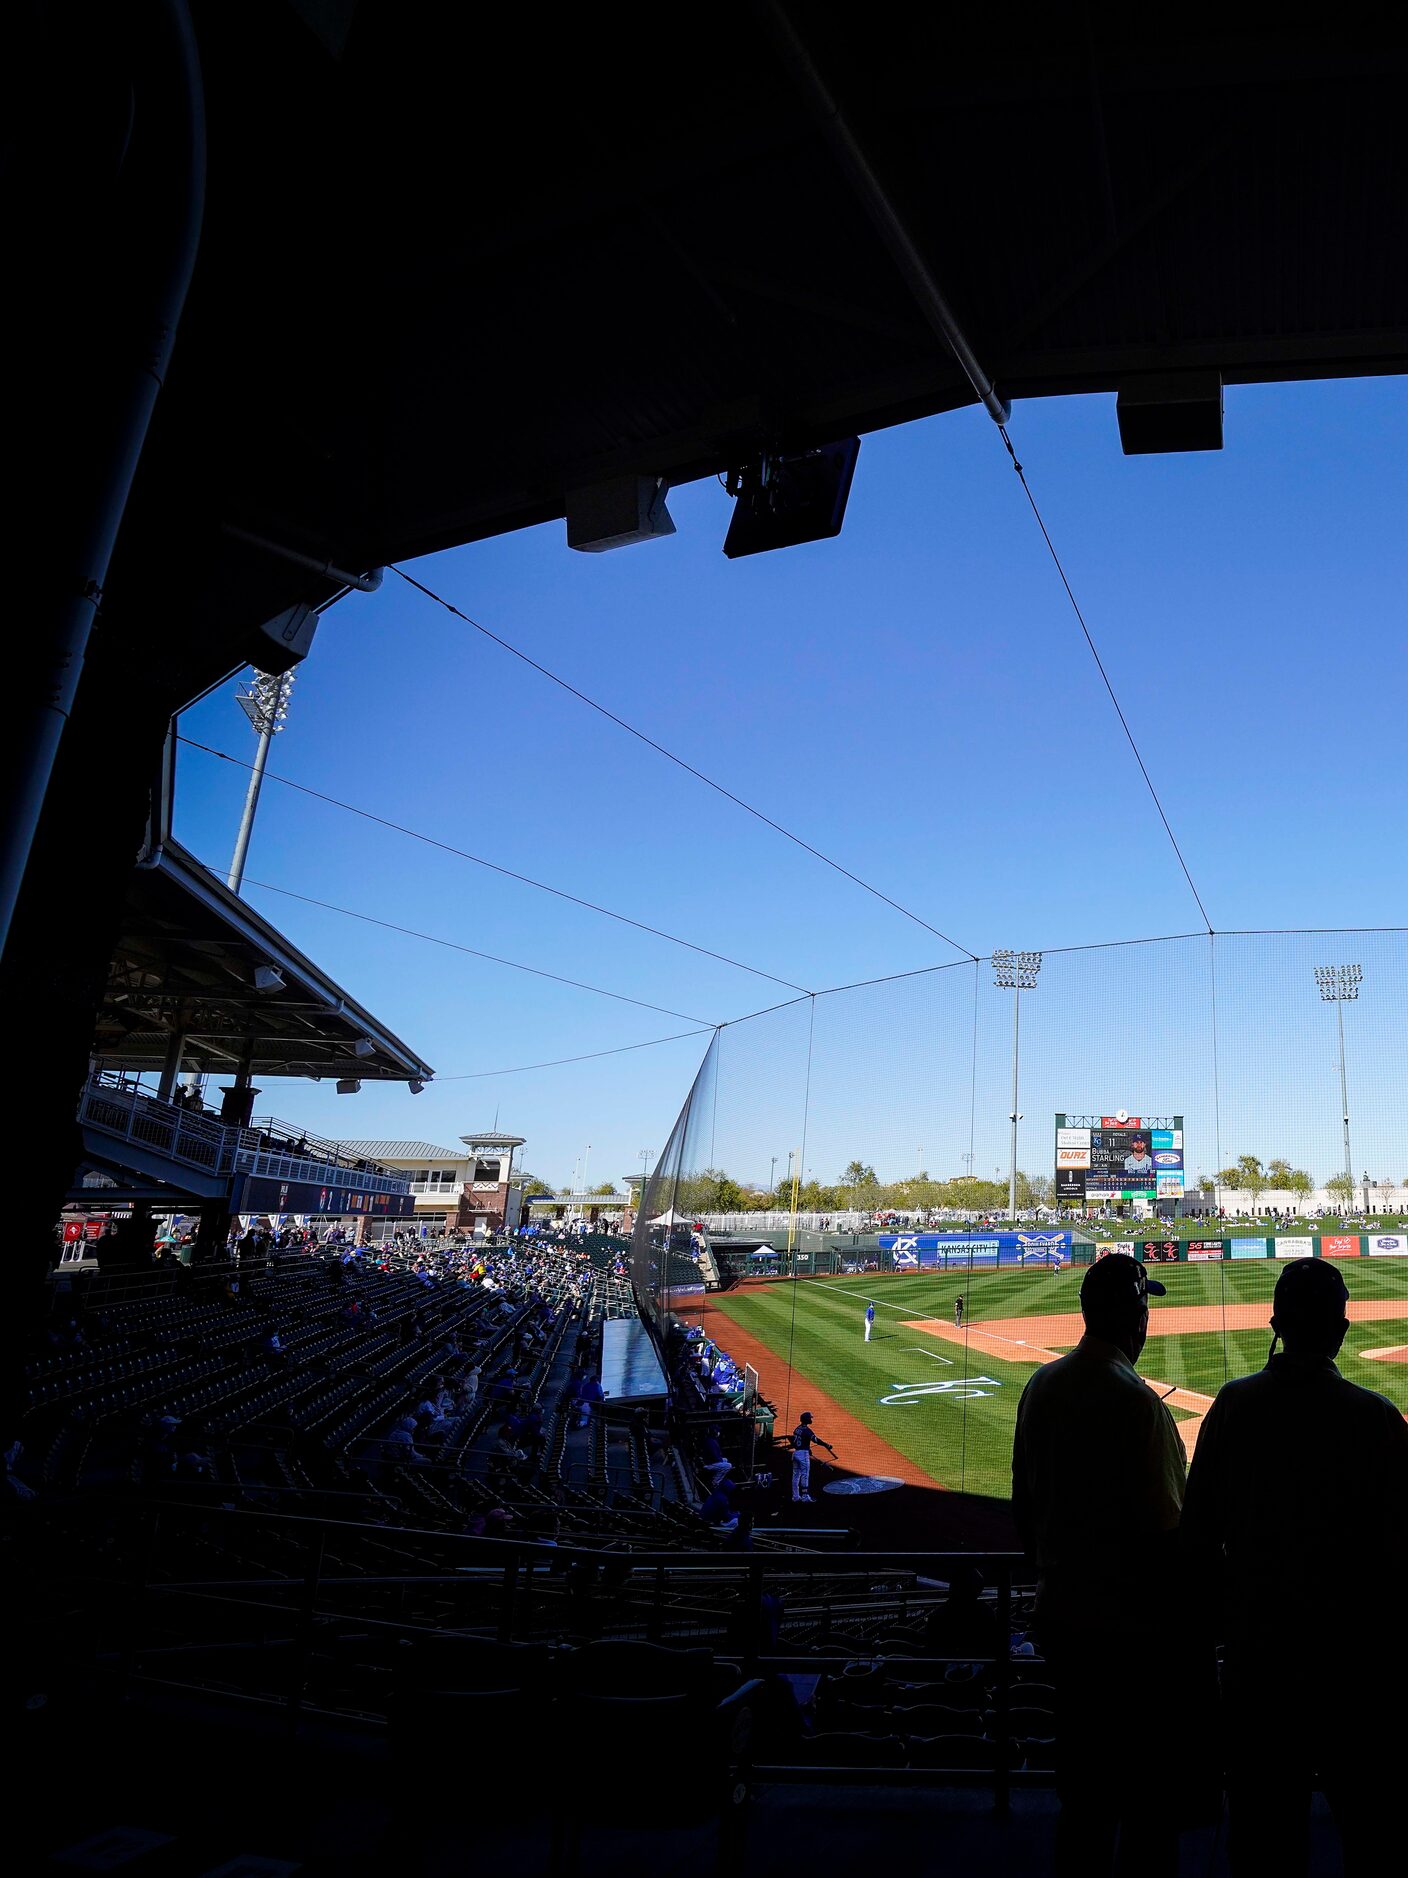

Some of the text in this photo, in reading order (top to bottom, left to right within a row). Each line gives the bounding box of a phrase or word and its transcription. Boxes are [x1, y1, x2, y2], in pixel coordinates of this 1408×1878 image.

[1109, 1138, 1115, 1147] 11
[941, 1244, 988, 1254] KANSAS CITY
